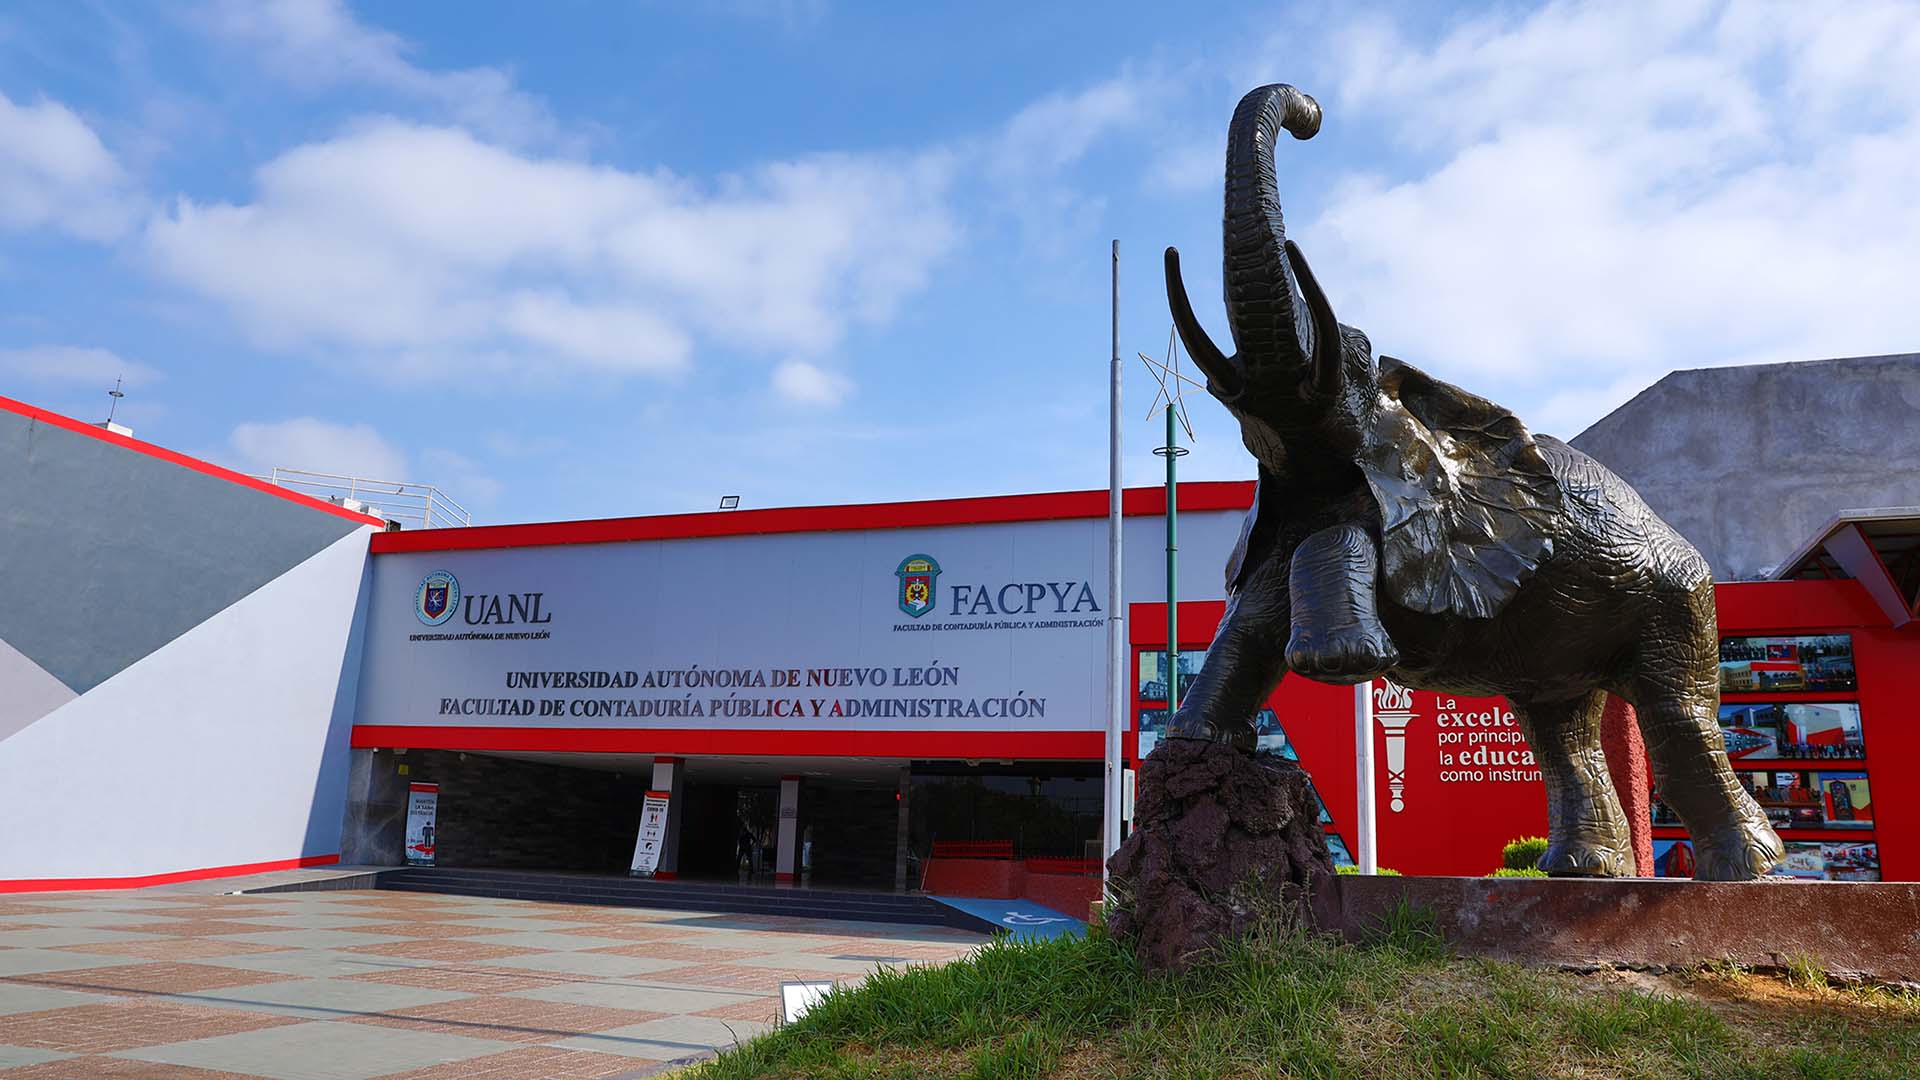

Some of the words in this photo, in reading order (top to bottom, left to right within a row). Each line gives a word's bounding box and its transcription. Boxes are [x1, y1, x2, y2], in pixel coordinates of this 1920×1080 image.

[950, 581, 1102, 616] FACPYA
[464, 593, 552, 625] UANL
[893, 624, 931, 632] FACULTAD
[944, 620, 993, 631] CONTADURÍA
[994, 619, 1027, 630] PÚBLICA
[1035, 617, 1104, 629] ADMINISTRACIÓN
[409, 633, 455, 642] UNIVERSIDAD
[455, 631, 494, 641] AUTÓNOMA
[505, 632, 530, 640] NUEVO
[531, 629, 550, 640] LEÓN
[506, 671, 639, 689] UNIVERSIDAD
[641, 665, 766, 688] AUTÓNOMA
[770, 669, 801, 687] DE
[806, 667, 887, 687] NUEVO
[892, 660, 960, 687] LEÓN
[439, 698, 535, 716] FACULTAD
[539, 699, 565, 717] DE
[569, 693, 705, 717] CONTADURÍA
[708, 692, 805, 718] PÚBLICA
[809, 699, 827, 718] Y
[828, 690, 1046, 718] ADMINISTRACIÓN
[1436, 695, 1456, 710] La
[1438, 731, 1464, 747] por
[1439, 750, 1453, 766] la
[1440, 770, 1484, 782] como
